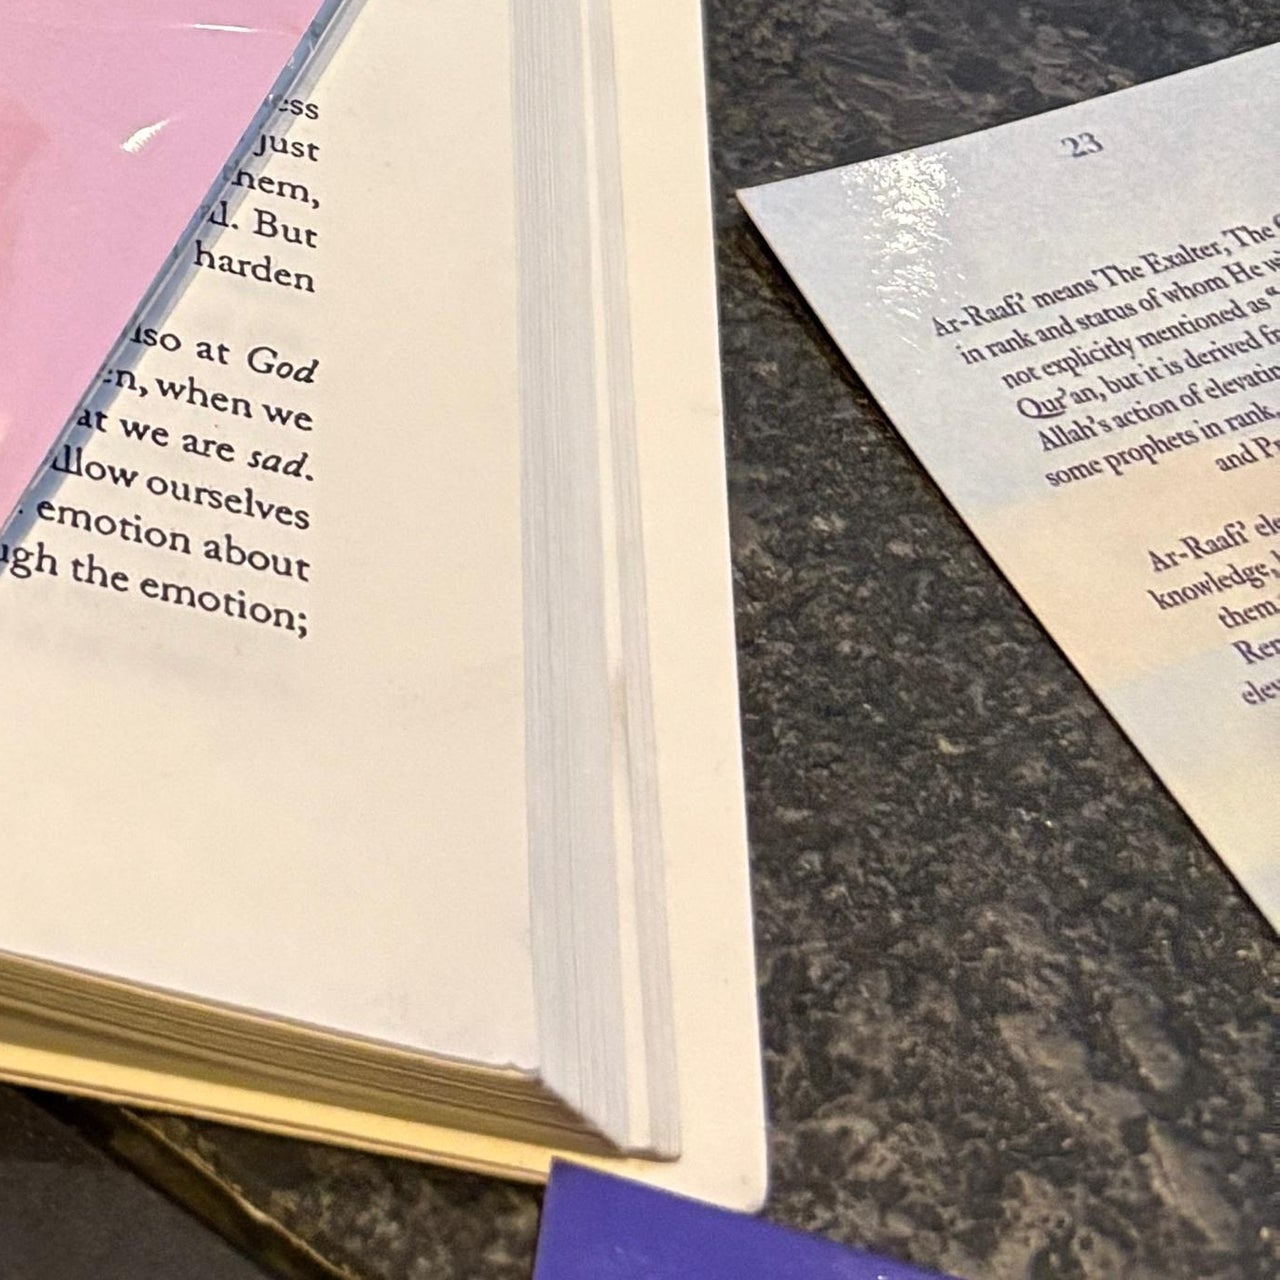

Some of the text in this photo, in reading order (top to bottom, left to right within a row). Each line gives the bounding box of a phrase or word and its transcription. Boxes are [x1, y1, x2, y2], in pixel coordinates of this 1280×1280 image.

[1060, 131, 1104, 158] 23
[252, 207, 319, 249] But
[192, 238, 317, 294] harden
[931, 225, 1277, 338] Ar-Raafi’ means The Exalter, The
[960, 261, 1266, 365] in rank and status of whom He
[1001, 297, 1272, 390] not explicitly mentioned as
[195, 341, 320, 384] at God
[1016, 386, 1108, 420] Qur’an,
[1097, 372, 1145, 394] but
[1137, 363, 1165, 383] it
[1156, 356, 1185, 377] is
[1183, 329, 1264, 369] derived
[154, 375, 253, 419] when
[261, 403, 313, 432] we
[1037, 415, 1114, 452] Allah’s
[1111, 399, 1181, 429] action
[1178, 382, 1206, 408] of
[119, 418, 170, 448] we
[181, 433, 236, 463] are
[246, 450, 314, 482] sad.
[1044, 459, 1104, 487] some
[1102, 429, 1201, 477] prophets
[1192, 419, 1227, 440] in
[1215, 442, 1260, 472] and
[146, 475, 310, 531] ourselves
[36, 499, 311, 583] emotion about
[1148, 520, 1250, 573] Ar-Raafi’
[71, 553, 130, 593] the
[139, 577, 308, 640] emotion;
